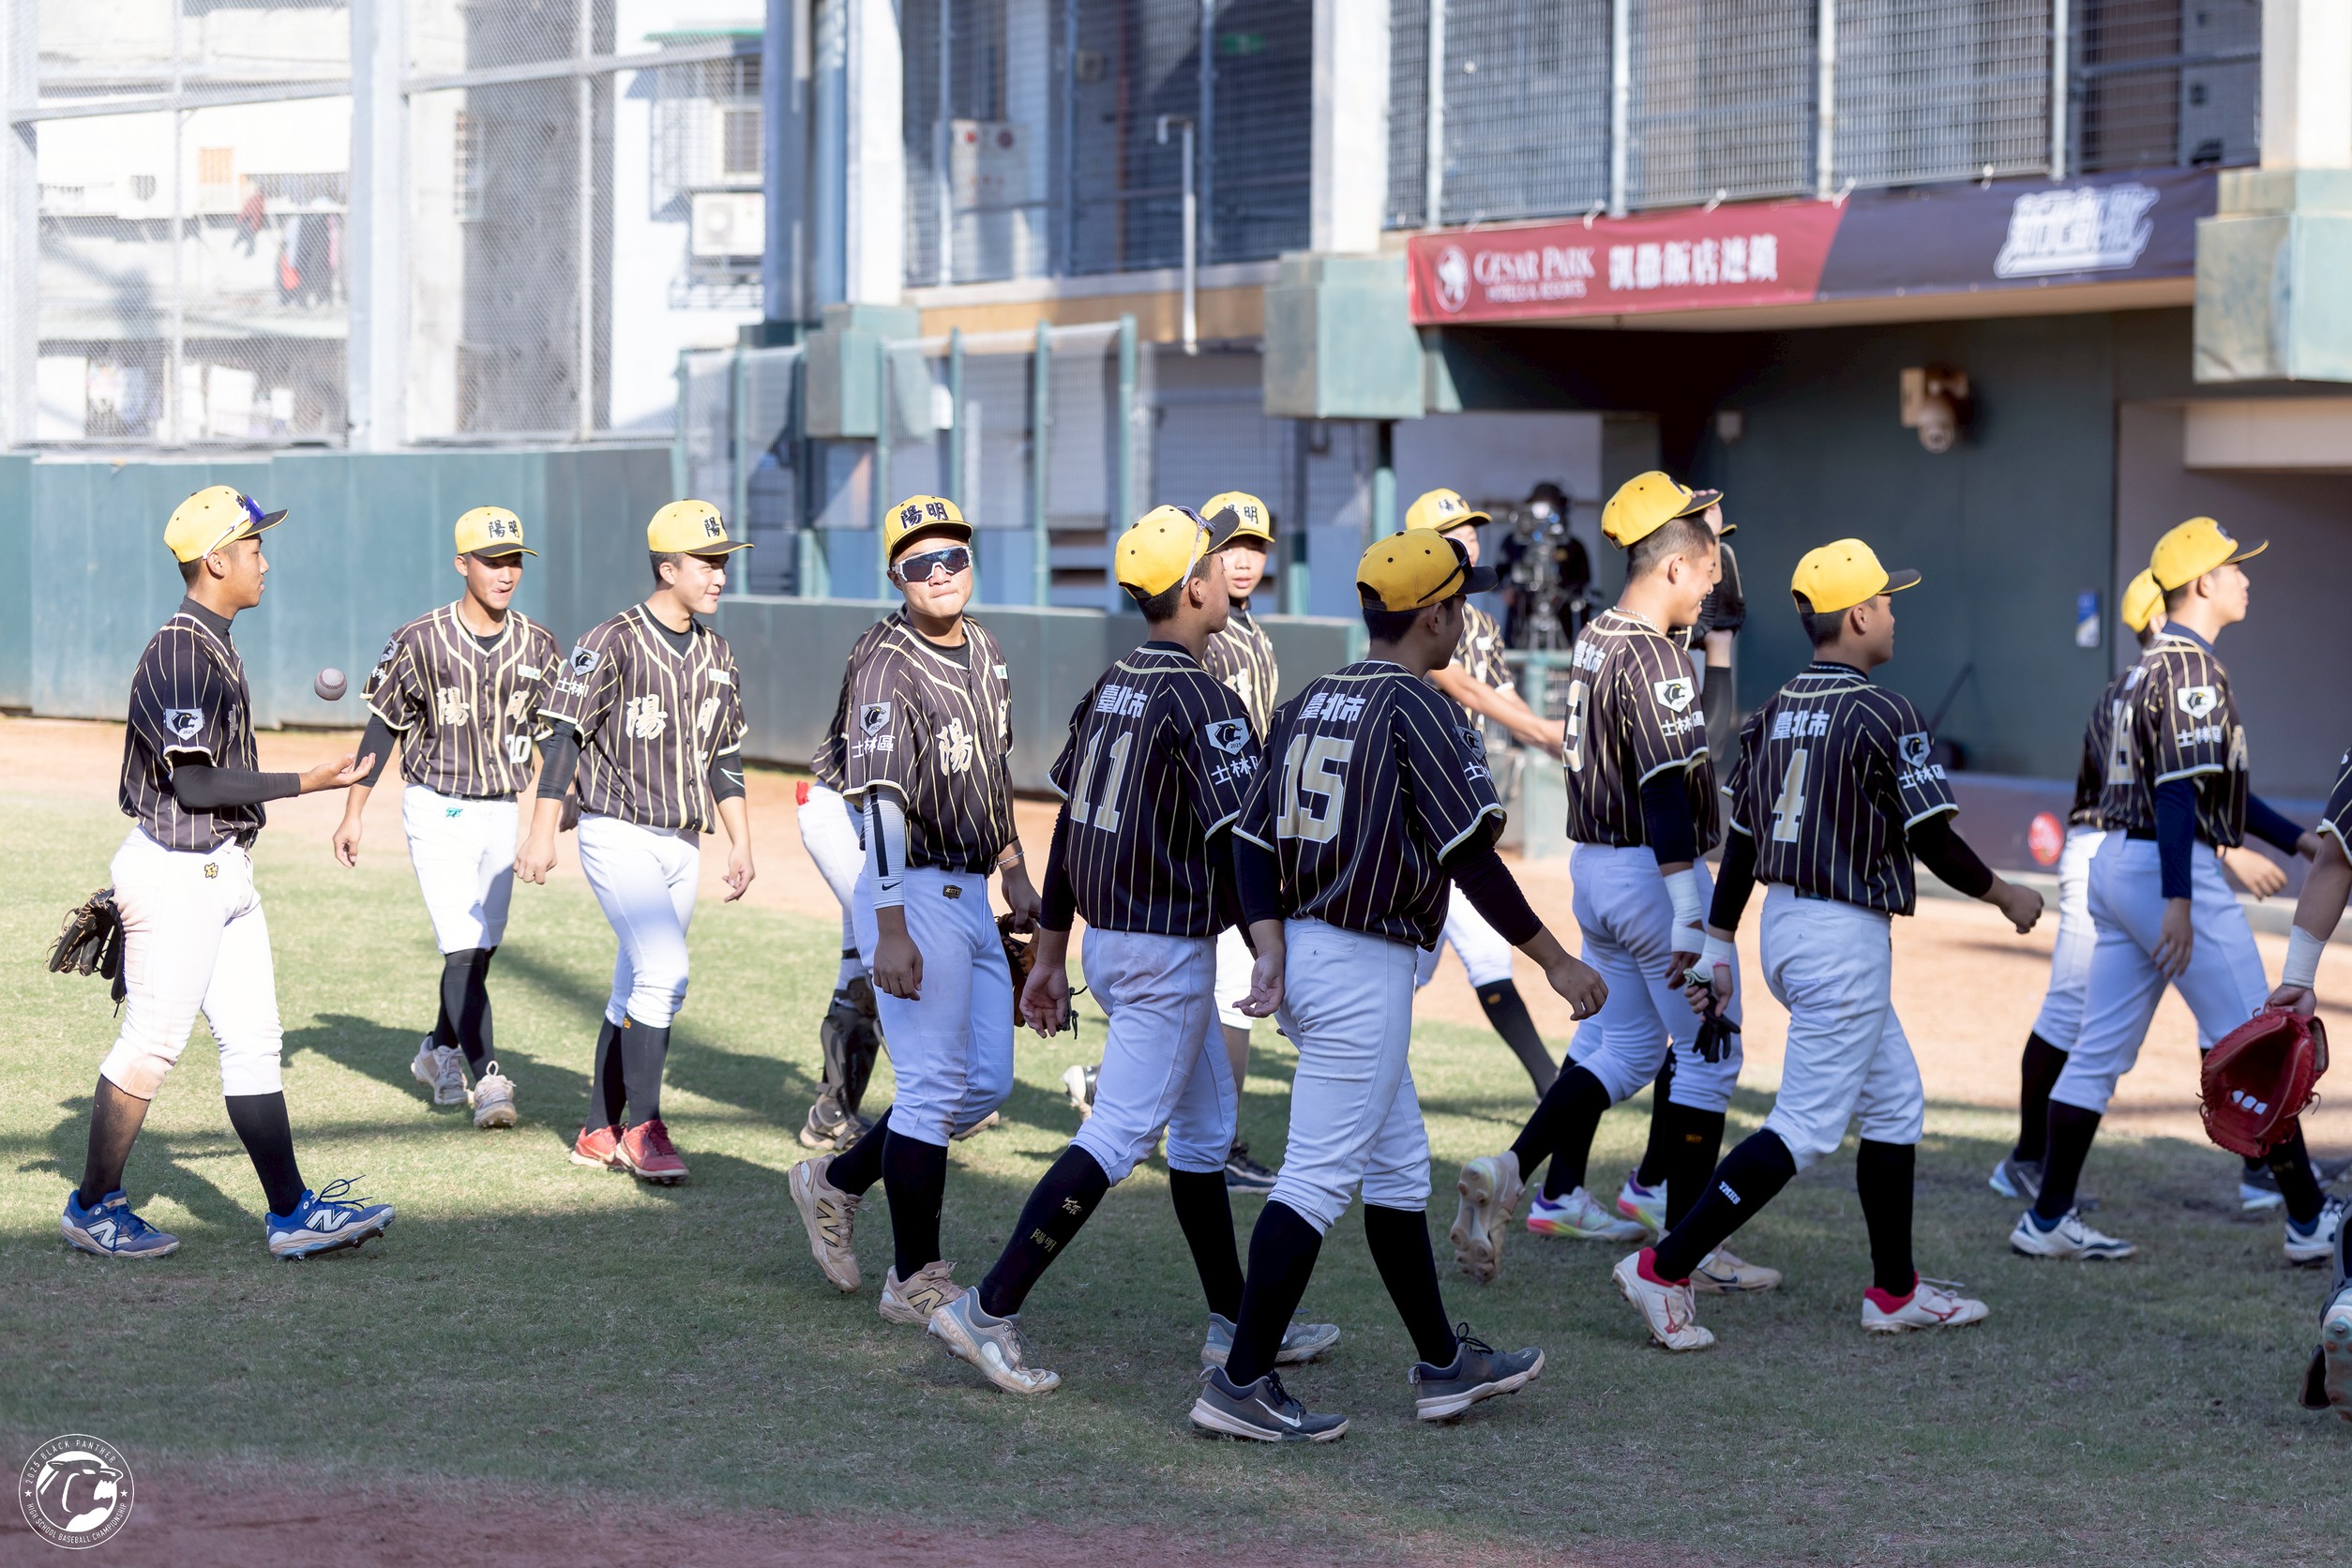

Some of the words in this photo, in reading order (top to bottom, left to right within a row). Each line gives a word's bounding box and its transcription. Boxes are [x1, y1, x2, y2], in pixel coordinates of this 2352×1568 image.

[1542, 246, 1595, 279] PARK
[488, 519, 520, 538] 陽明
[900, 502, 949, 530] 陽明
[1095, 684, 1149, 718] 臺北市
[1298, 692, 1367, 723] 臺北市
[1772, 710, 1830, 740] 臺北市
[852, 734, 896, 759] 士林區
[1070, 725, 1133, 833] 11
[1277, 733, 1354, 844] 15
[1898, 764, 1947, 790] 士林區
[1772, 748, 1809, 843] 4
[1718, 1181, 1741, 1205] YMHS
[1030, 1228, 1057, 1253] 陽明
